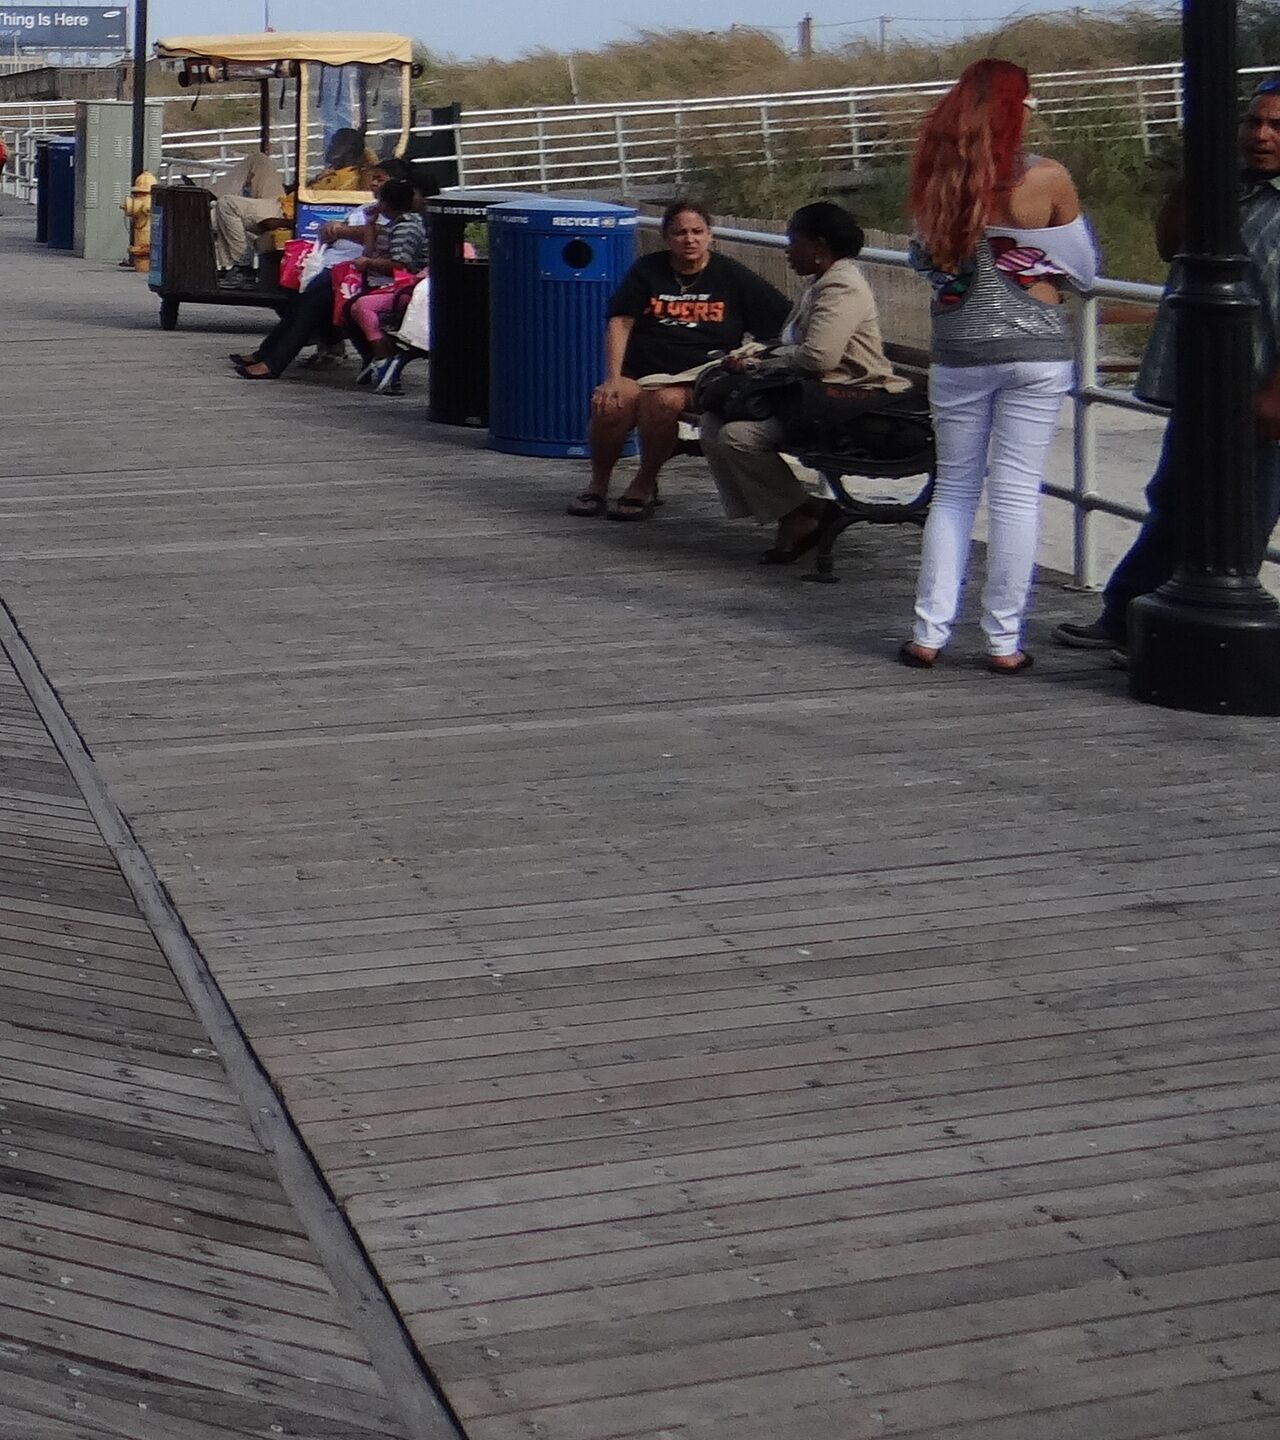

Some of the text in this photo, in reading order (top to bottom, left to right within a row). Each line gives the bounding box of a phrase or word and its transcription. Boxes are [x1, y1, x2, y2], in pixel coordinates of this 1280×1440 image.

[38, 13, 51, 26] Is
[54, 13, 88, 26] Here
[443, 207, 488, 216] DISTRICT
[552, 216, 599, 227] RECYCLE
